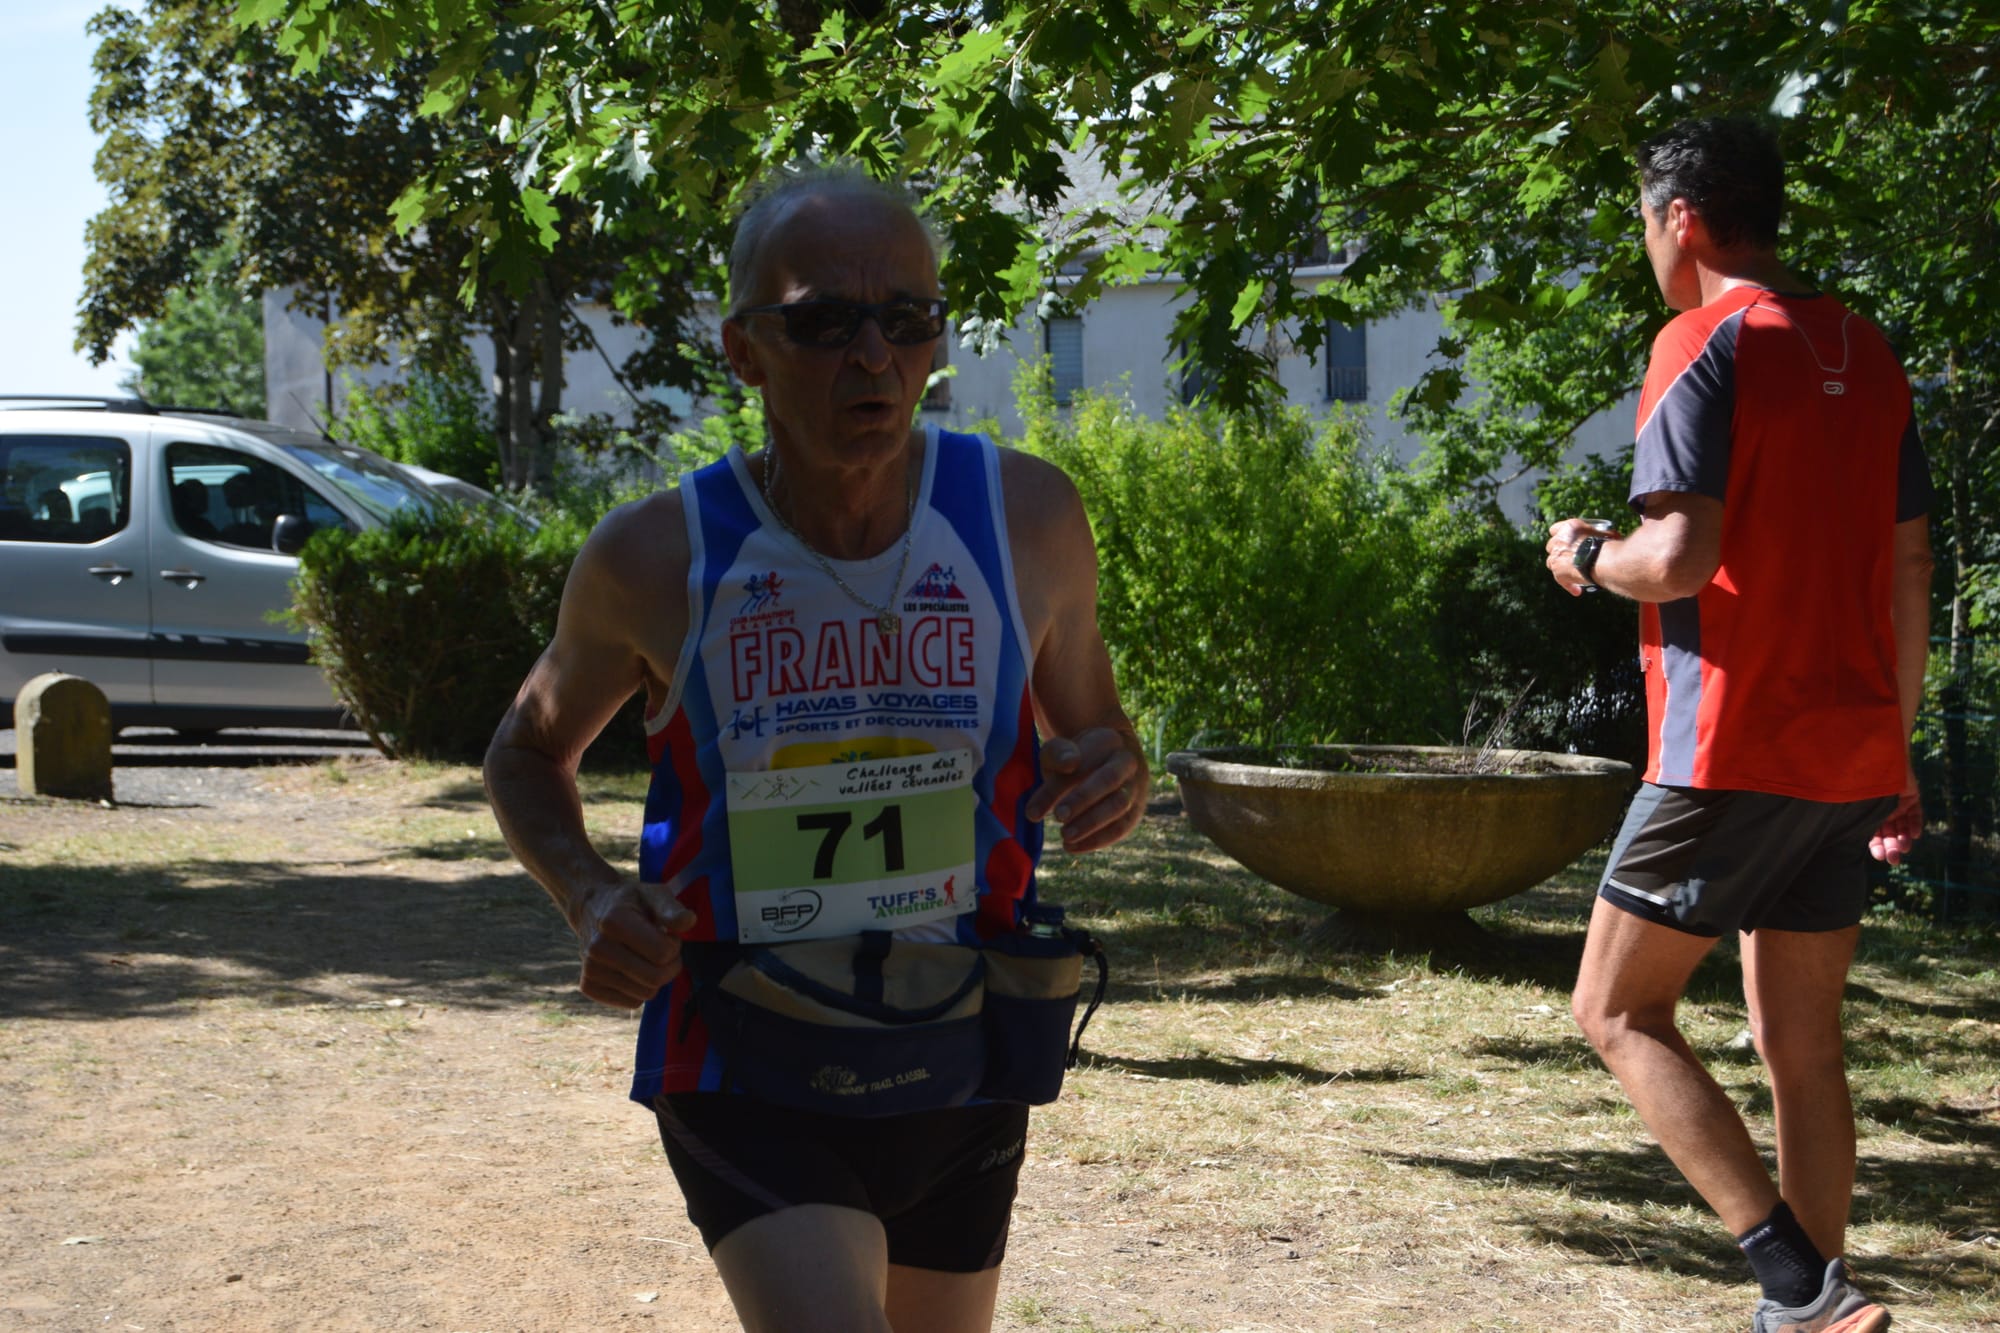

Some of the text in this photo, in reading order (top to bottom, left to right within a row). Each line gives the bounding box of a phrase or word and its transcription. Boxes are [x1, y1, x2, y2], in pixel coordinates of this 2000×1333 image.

[903, 602, 917, 612] LES
[729, 616, 976, 702] FRANCE
[776, 692, 978, 717] HAVAS VOYAGES
[775, 716, 979, 736] SPORTS ET DECOUVERTES
[847, 757, 956, 780] Challenge des
[839, 779, 893, 795] vallées
[796, 804, 905, 880] 71
[867, 887, 937, 910] TUFF'S
[875, 897, 944, 919] Aventure
[761, 904, 814, 921] BFP
